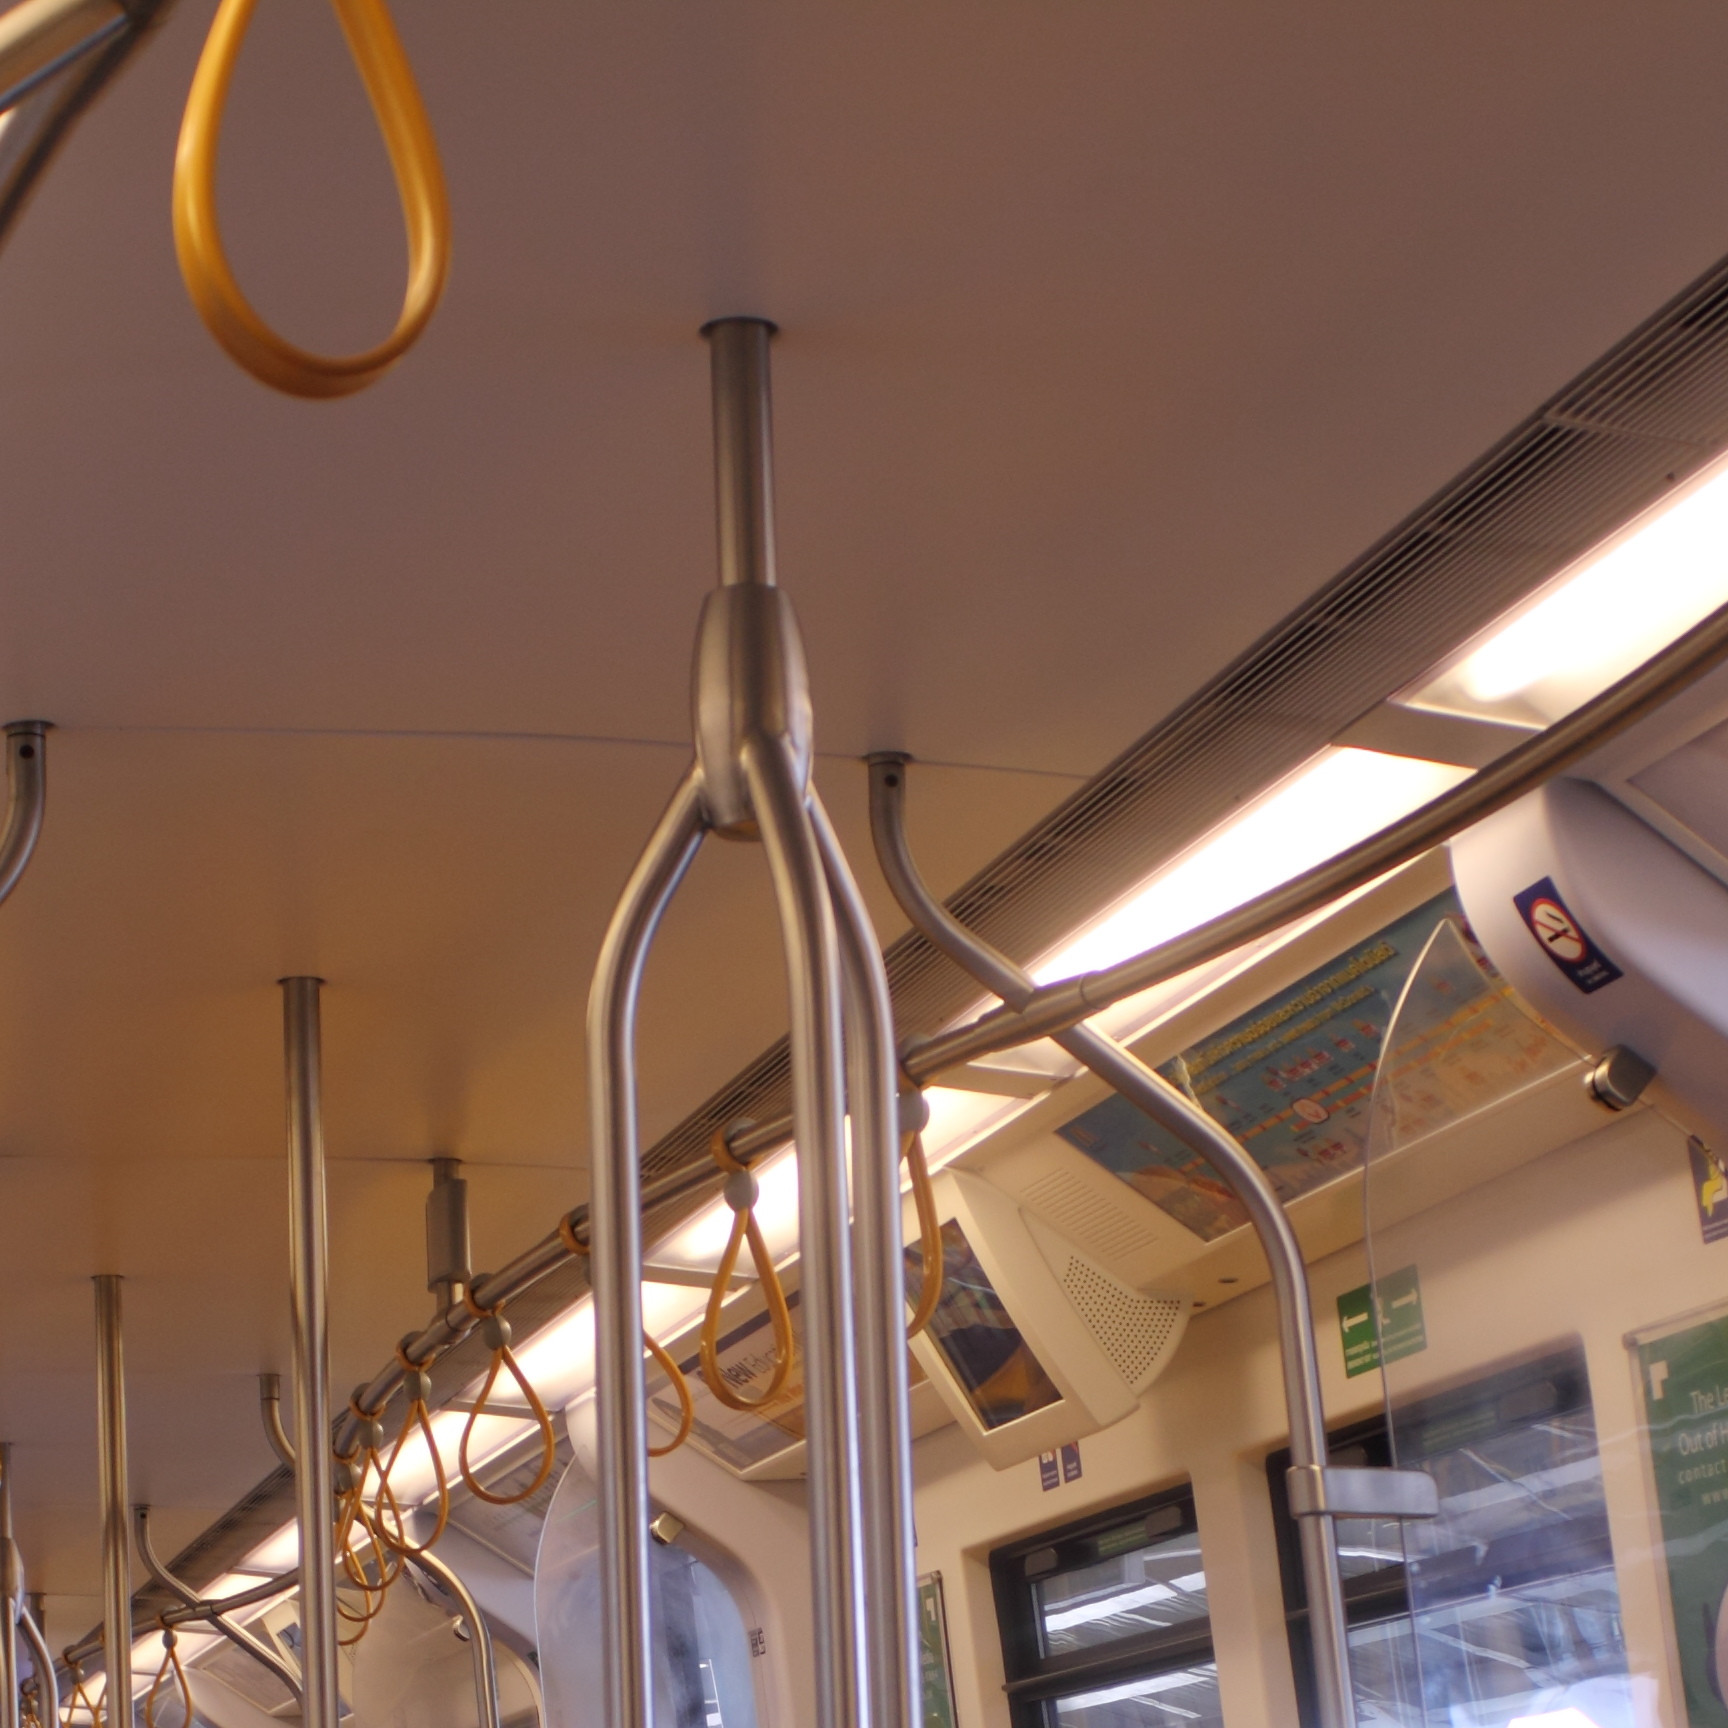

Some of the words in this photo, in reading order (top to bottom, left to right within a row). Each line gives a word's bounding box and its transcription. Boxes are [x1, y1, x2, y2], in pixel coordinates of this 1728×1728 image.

[1689, 1389, 1715, 1414] The
[1678, 1432, 1704, 1456] Out
[1705, 1420, 1719, 1449] of
[1678, 1458, 1727, 1484] contact
